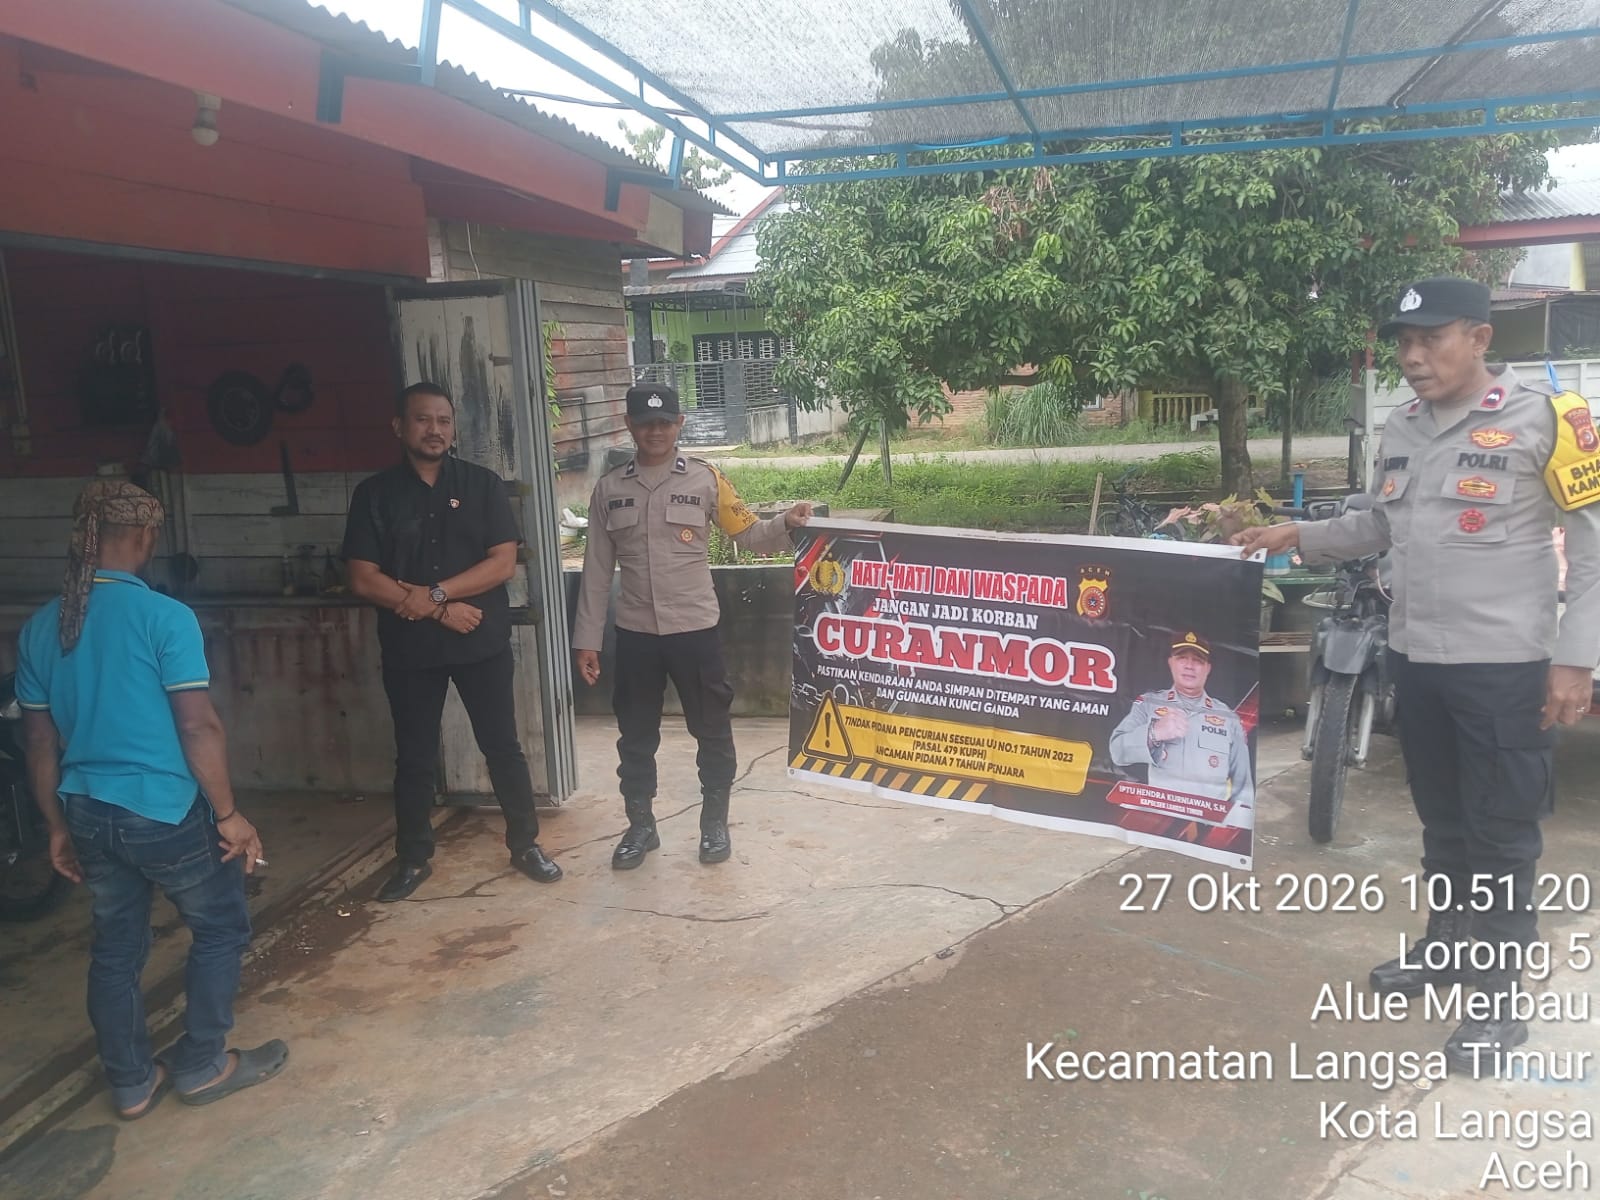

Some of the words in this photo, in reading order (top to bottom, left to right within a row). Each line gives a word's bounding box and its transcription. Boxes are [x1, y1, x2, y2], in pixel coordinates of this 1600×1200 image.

[1458, 453, 1508, 470] POLRI
[670, 494, 701, 505] POLRI
[1567, 474, 1600, 496] KAM
[851, 560, 932, 594] HATI-HATI
[933, 566, 971, 598] DAN
[973, 570, 1067, 609] WASPADA
[872, 598, 930, 618] JANGAN
[932, 604, 969, 622] JADI
[972, 609, 1039, 630] KORBAN
[813, 612, 1117, 694] CURANMOR
[817, 665, 858, 680] PASTIKAN
[858, 672, 914, 688] KENDARAAN
[915, 679, 942, 692] ANDA
[944, 684, 985, 698] SIMPAN
[1039, 697, 1071, 711] YANG
[1072, 702, 1109, 716] AMAN
[876, 687, 895, 699] DAN
[896, 690, 947, 707] GUNAKAN
[948, 698, 982, 713] KUNCI
[983, 702, 1020, 718] GANDA
[845, 716, 871, 729] TINDAK
[871, 721, 897, 735] PIDANA
[899, 726, 948, 742] PENCURIAN
[949, 734, 984, 748] SESEUAI
[998, 741, 1018, 754] NO.1
[1020, 745, 1050, 759] TAHUN
[1052, 750, 1074, 763] 2023
[912, 740, 942, 753] (PASAL
[943, 745, 958, 755] 479
[876, 745, 914, 761] ANCAMAN
[914, 751, 948, 765] PIDANA
[949, 755, 954, 765] 7
[956, 758, 989, 772] TAHUN
[987, 763, 1025, 778] PENJARA
[1119, 785, 1136, 795] IPTU
[1136, 788, 1165, 800] HENDRA
